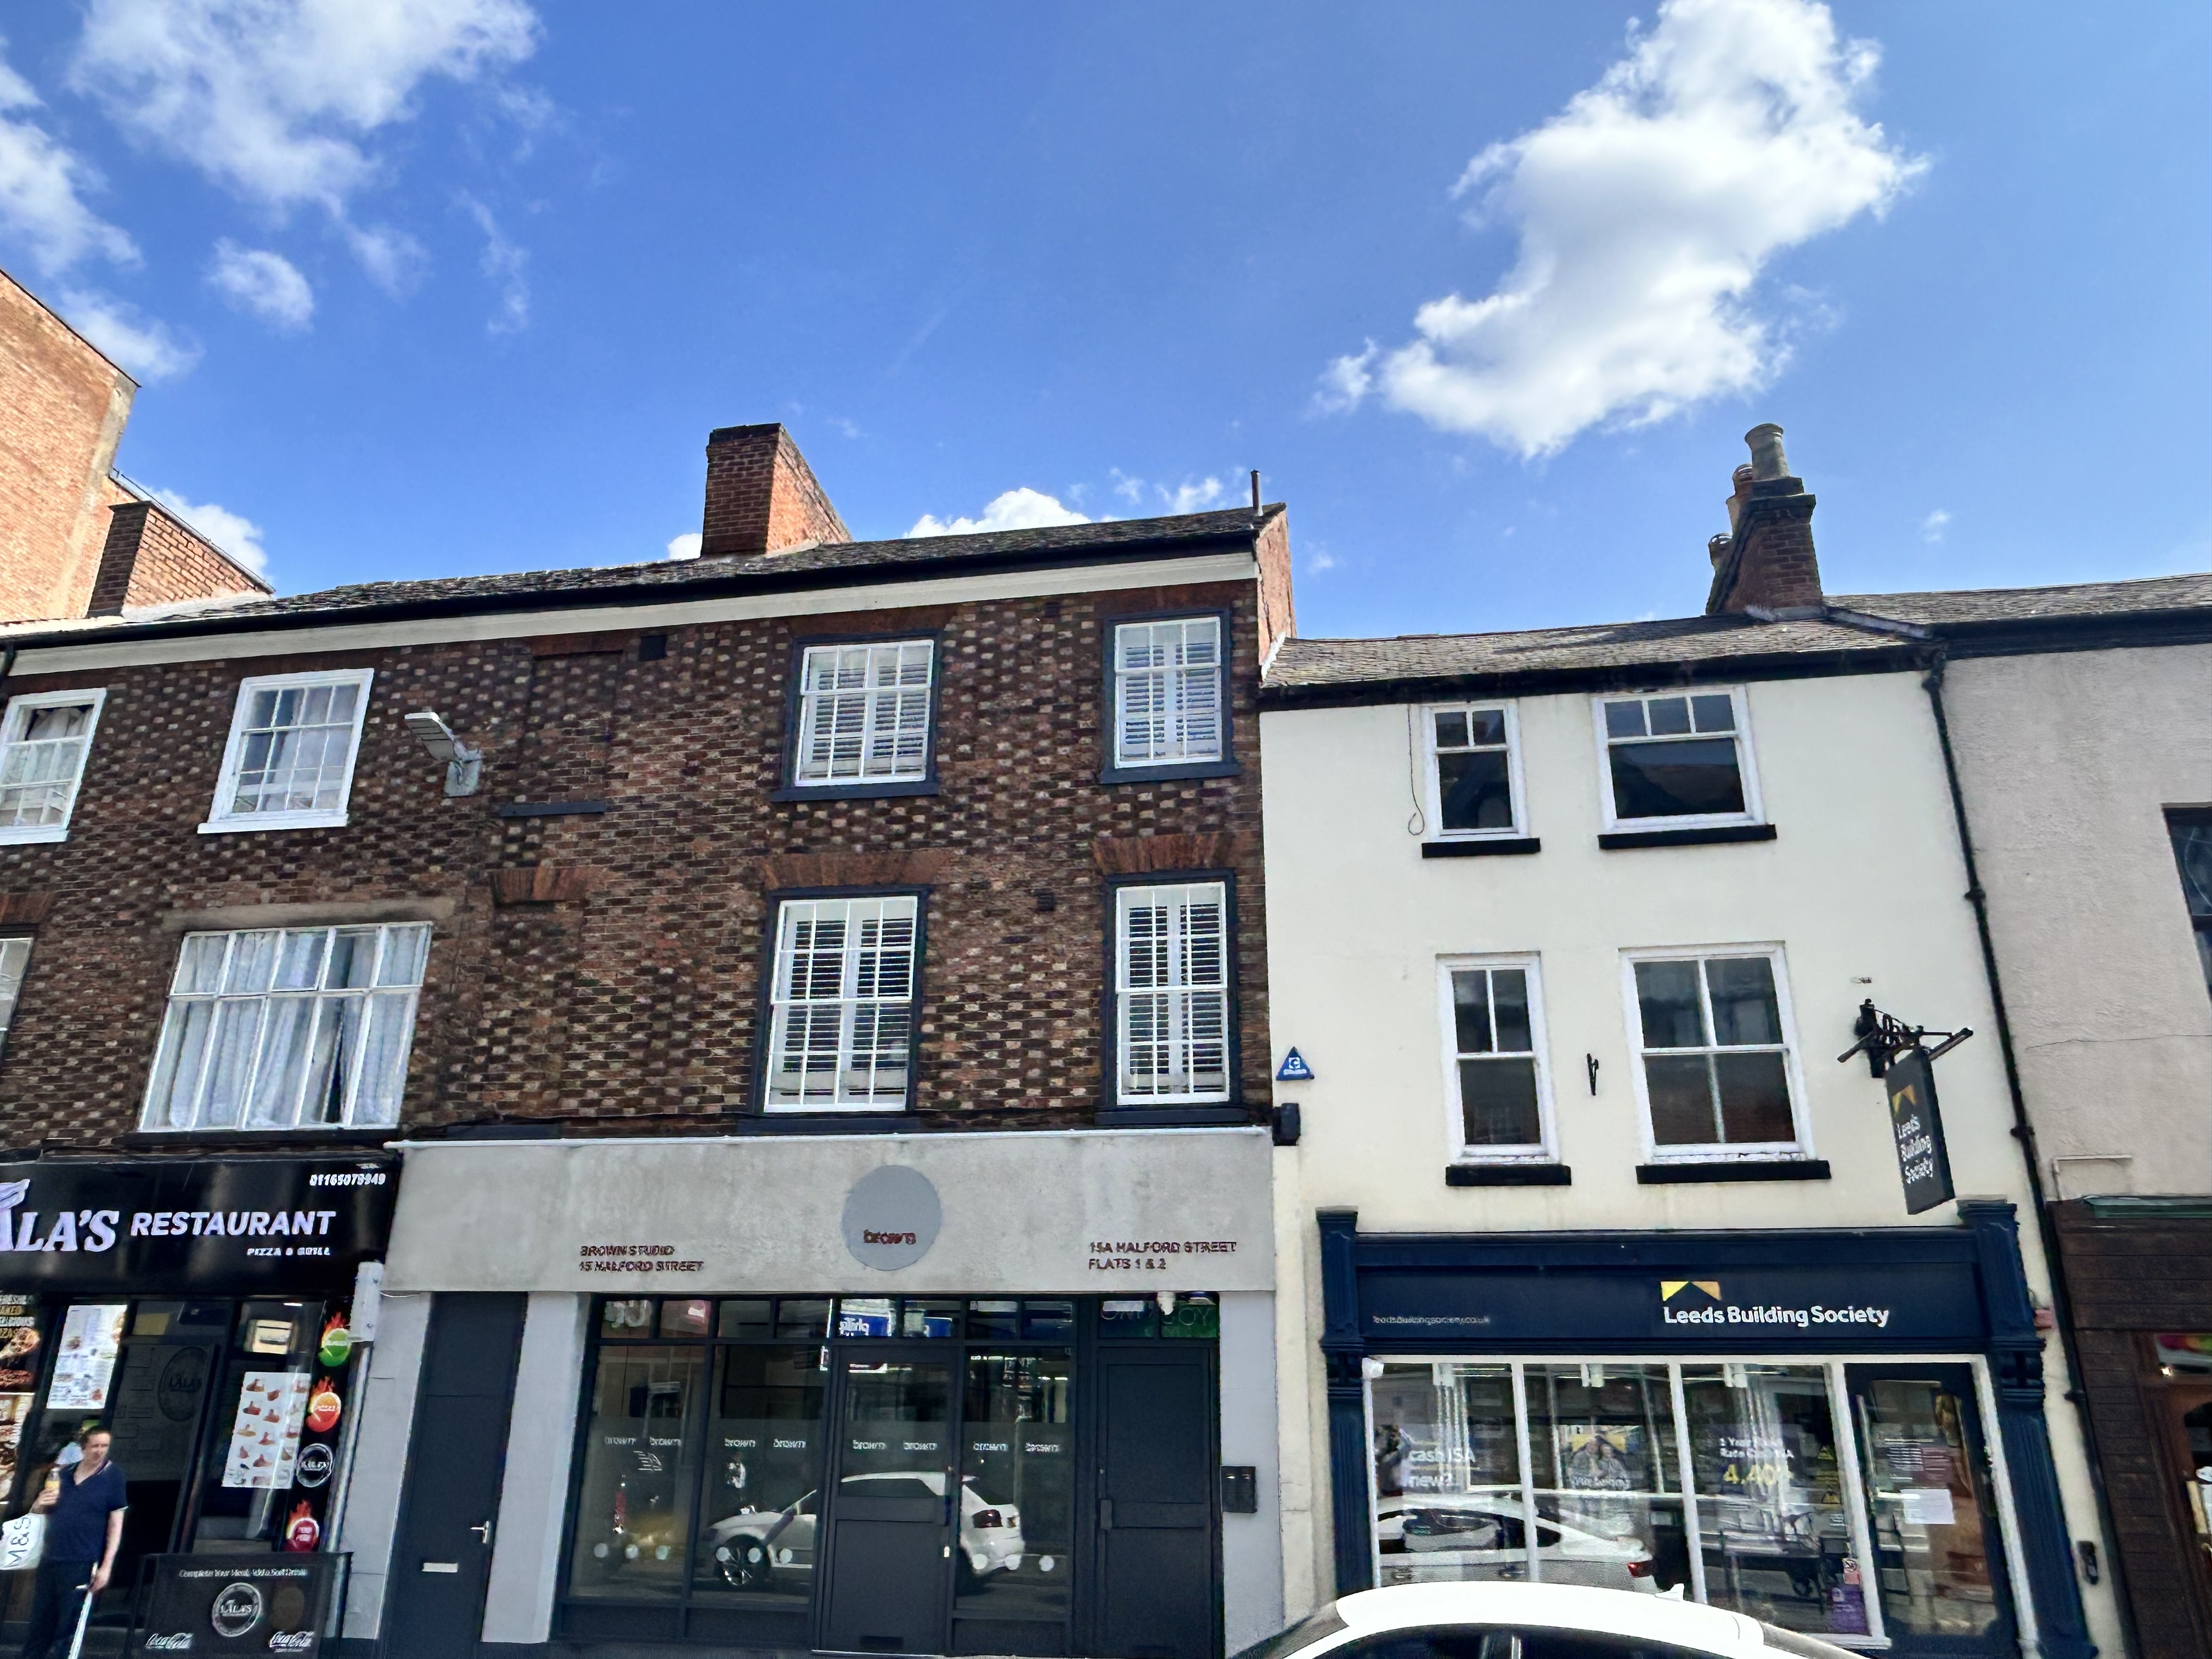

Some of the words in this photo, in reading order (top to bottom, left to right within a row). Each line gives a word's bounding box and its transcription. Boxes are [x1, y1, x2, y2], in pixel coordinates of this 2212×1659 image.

[131, 1211, 337, 1236] RESTAURANT
[247, 1248, 281, 1256] PIZZA
[580, 1245, 627, 1256] BROWN
[629, 1245, 675, 1256] STUDIO
[1116, 1242, 1181, 1254] HALFORD
[1183, 1242, 1237, 1253] STREET
[595, 1261, 654, 1272] HALFORD
[656, 1261, 705, 1272] STREET
[1088, 1259, 1131, 1270] FLATS
[1157, 1258, 1167, 1269] 2
[1663, 1306, 1725, 1323] Leeds
[1727, 1306, 1809, 1328] Building
[1810, 1306, 1889, 1328] Society
[4, 1517, 31, 1567] M&S
